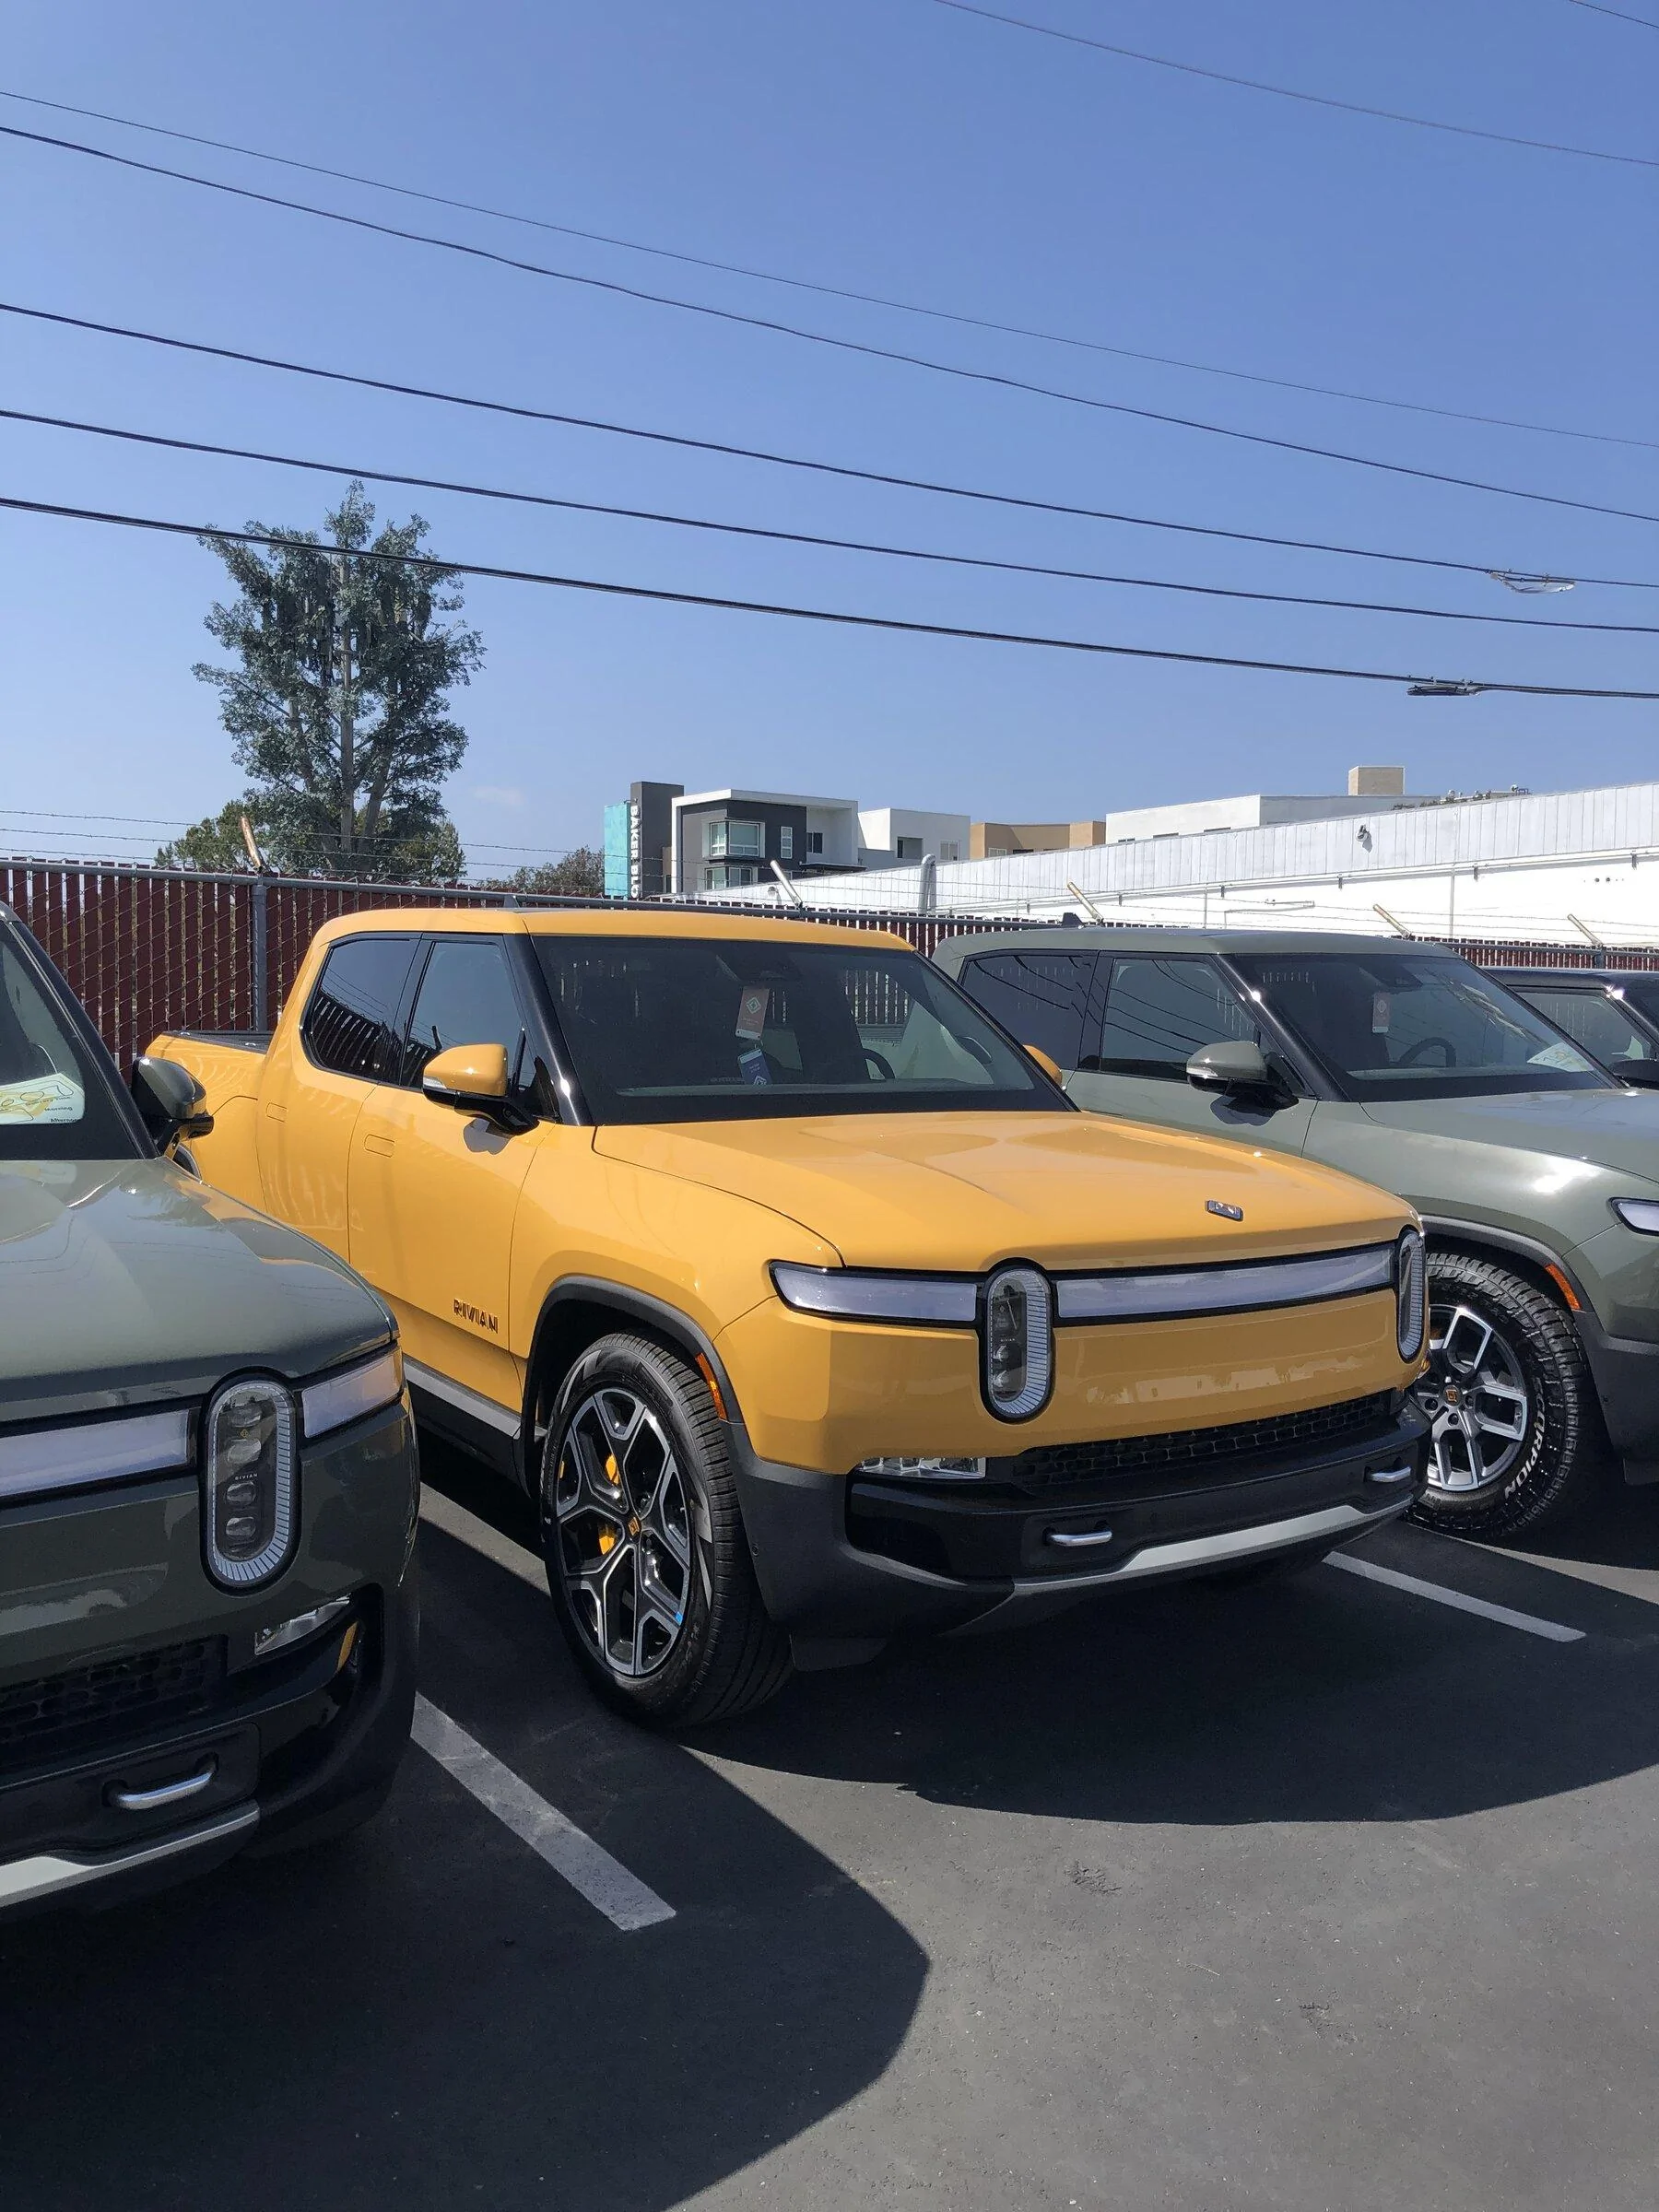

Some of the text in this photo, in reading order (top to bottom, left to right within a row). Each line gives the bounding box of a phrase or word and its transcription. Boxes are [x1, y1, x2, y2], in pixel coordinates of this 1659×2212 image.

[630, 806, 639, 861] BAKER
[453, 1298, 499, 1335] RIVIAN
[1504, 1376, 1546, 1500] SCORPION
